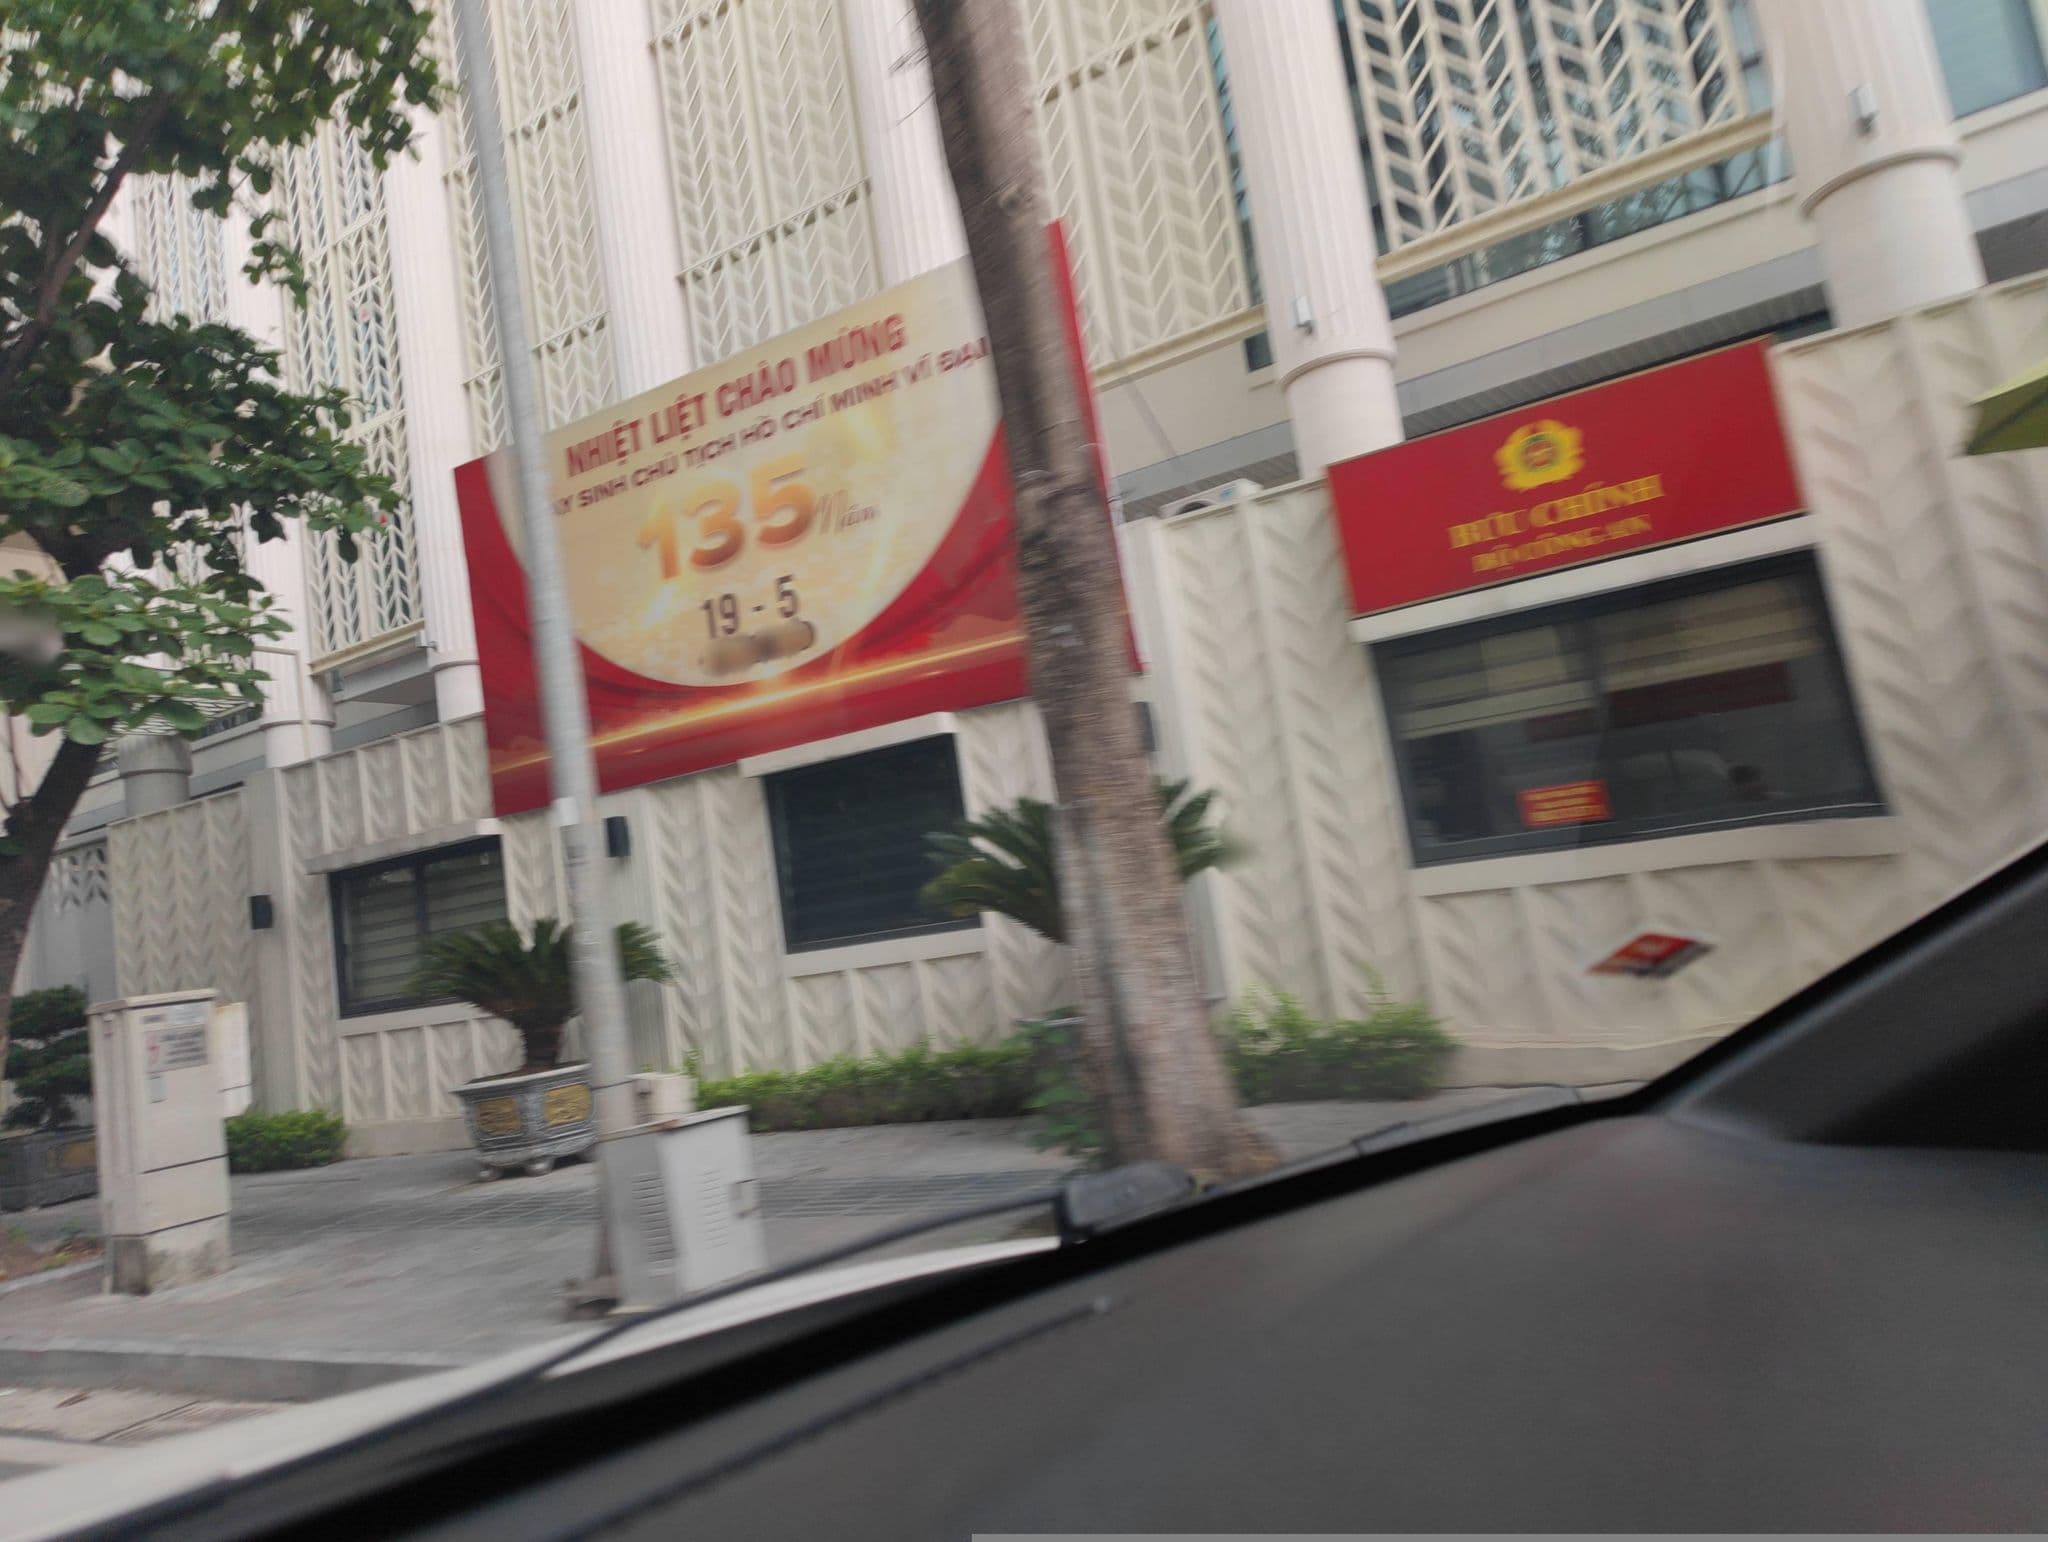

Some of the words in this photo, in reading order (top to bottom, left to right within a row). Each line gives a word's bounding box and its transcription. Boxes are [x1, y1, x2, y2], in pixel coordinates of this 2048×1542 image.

[566, 418, 642, 477] NHIỆT
[649, 393, 706, 444] LIỆT
[715, 357, 796, 417] CHÀO
[806, 312, 908, 383] MỪNG
[577, 475, 628, 508] SINH
[631, 452, 680, 486] CHỦ
[683, 433, 736, 468] TỊCH
[740, 415, 777, 447] HỒ
[781, 393, 826, 430] CHÍ
[830, 370, 898, 413] MINH
[638, 453, 816, 580] 135
[1529, 473, 1665, 527] CHÍNH
[700, 593, 739, 639] 19
[775, 574, 798, 619] 5
